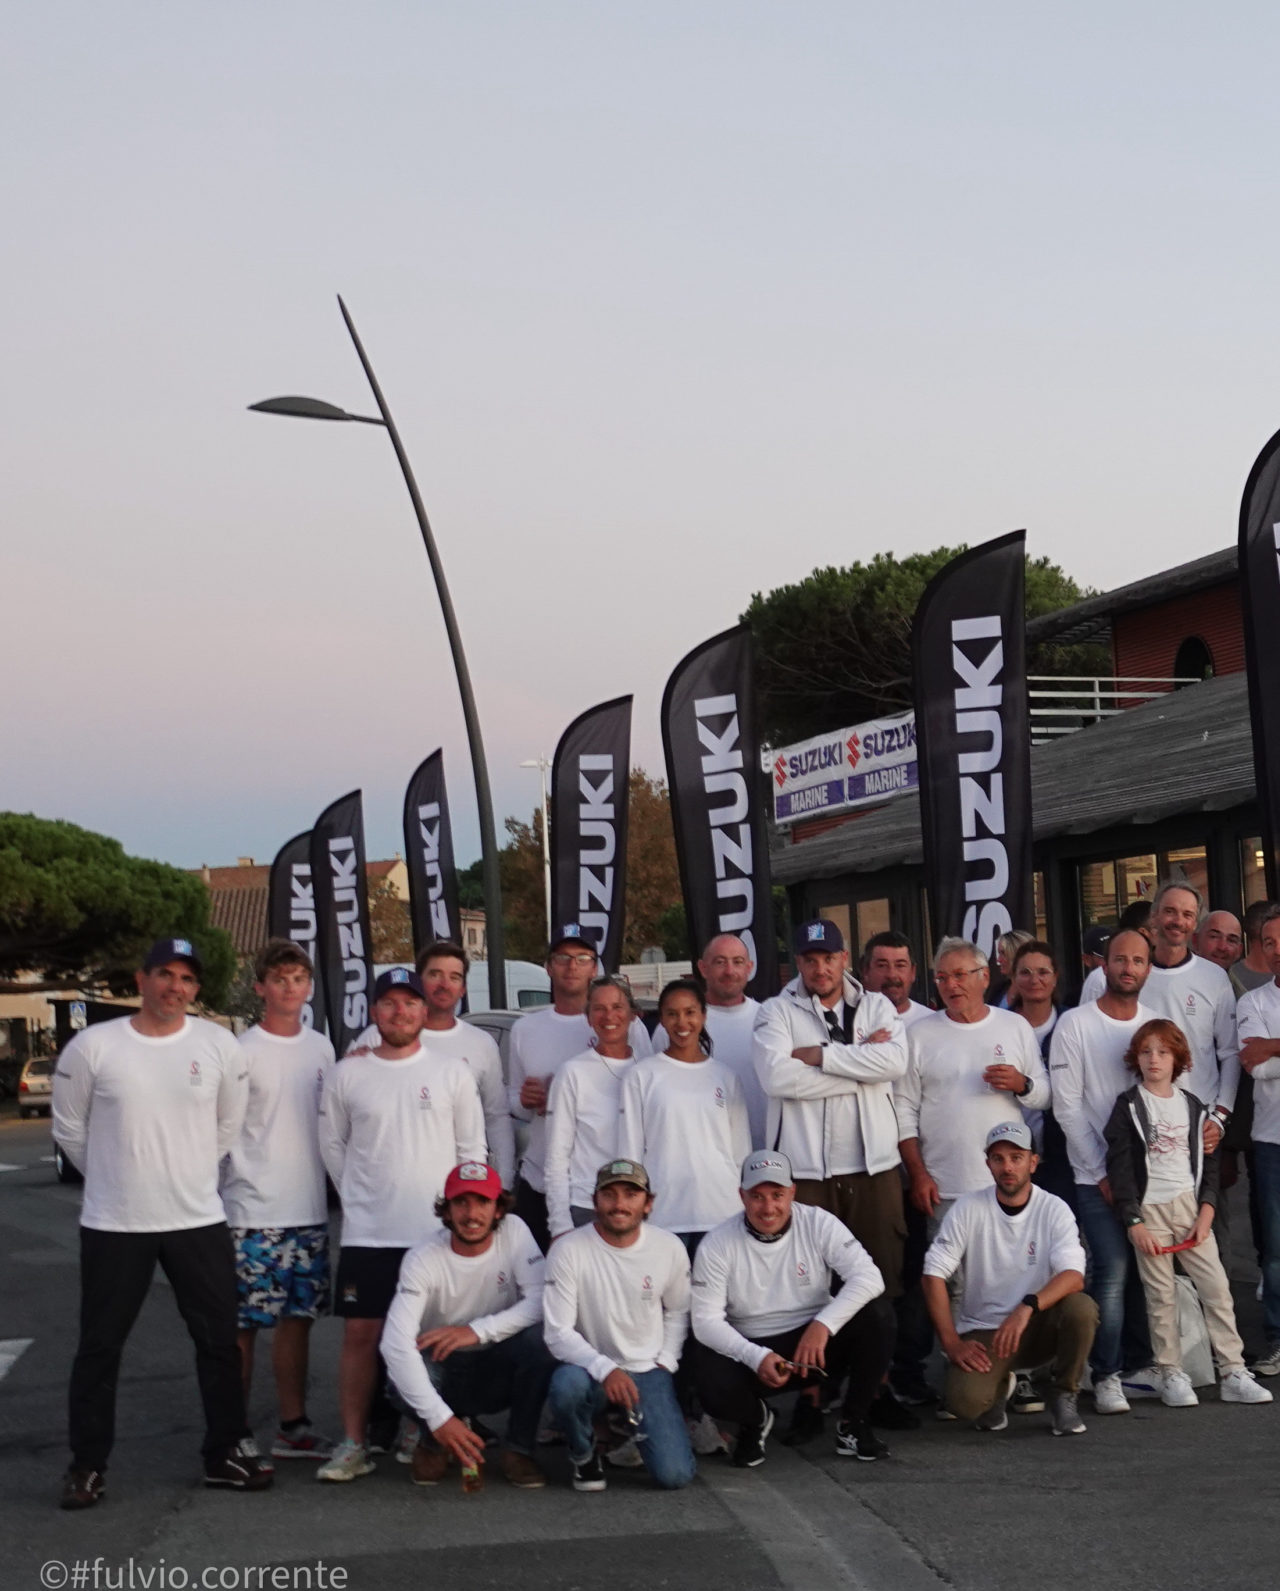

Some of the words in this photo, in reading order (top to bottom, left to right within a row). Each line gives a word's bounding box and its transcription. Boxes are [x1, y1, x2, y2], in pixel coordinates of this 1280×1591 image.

[789, 740, 843, 779] SUZUKI
[862, 722, 918, 760] SUZUK
[865, 765, 908, 796] MARINE
[790, 785, 829, 813] MARINE
[952, 615, 1012, 966] SUZUKI
[418, 801, 451, 943] ZUKI
[579, 754, 616, 977] UZUKI
[328, 836, 368, 1030] SUZUKI
